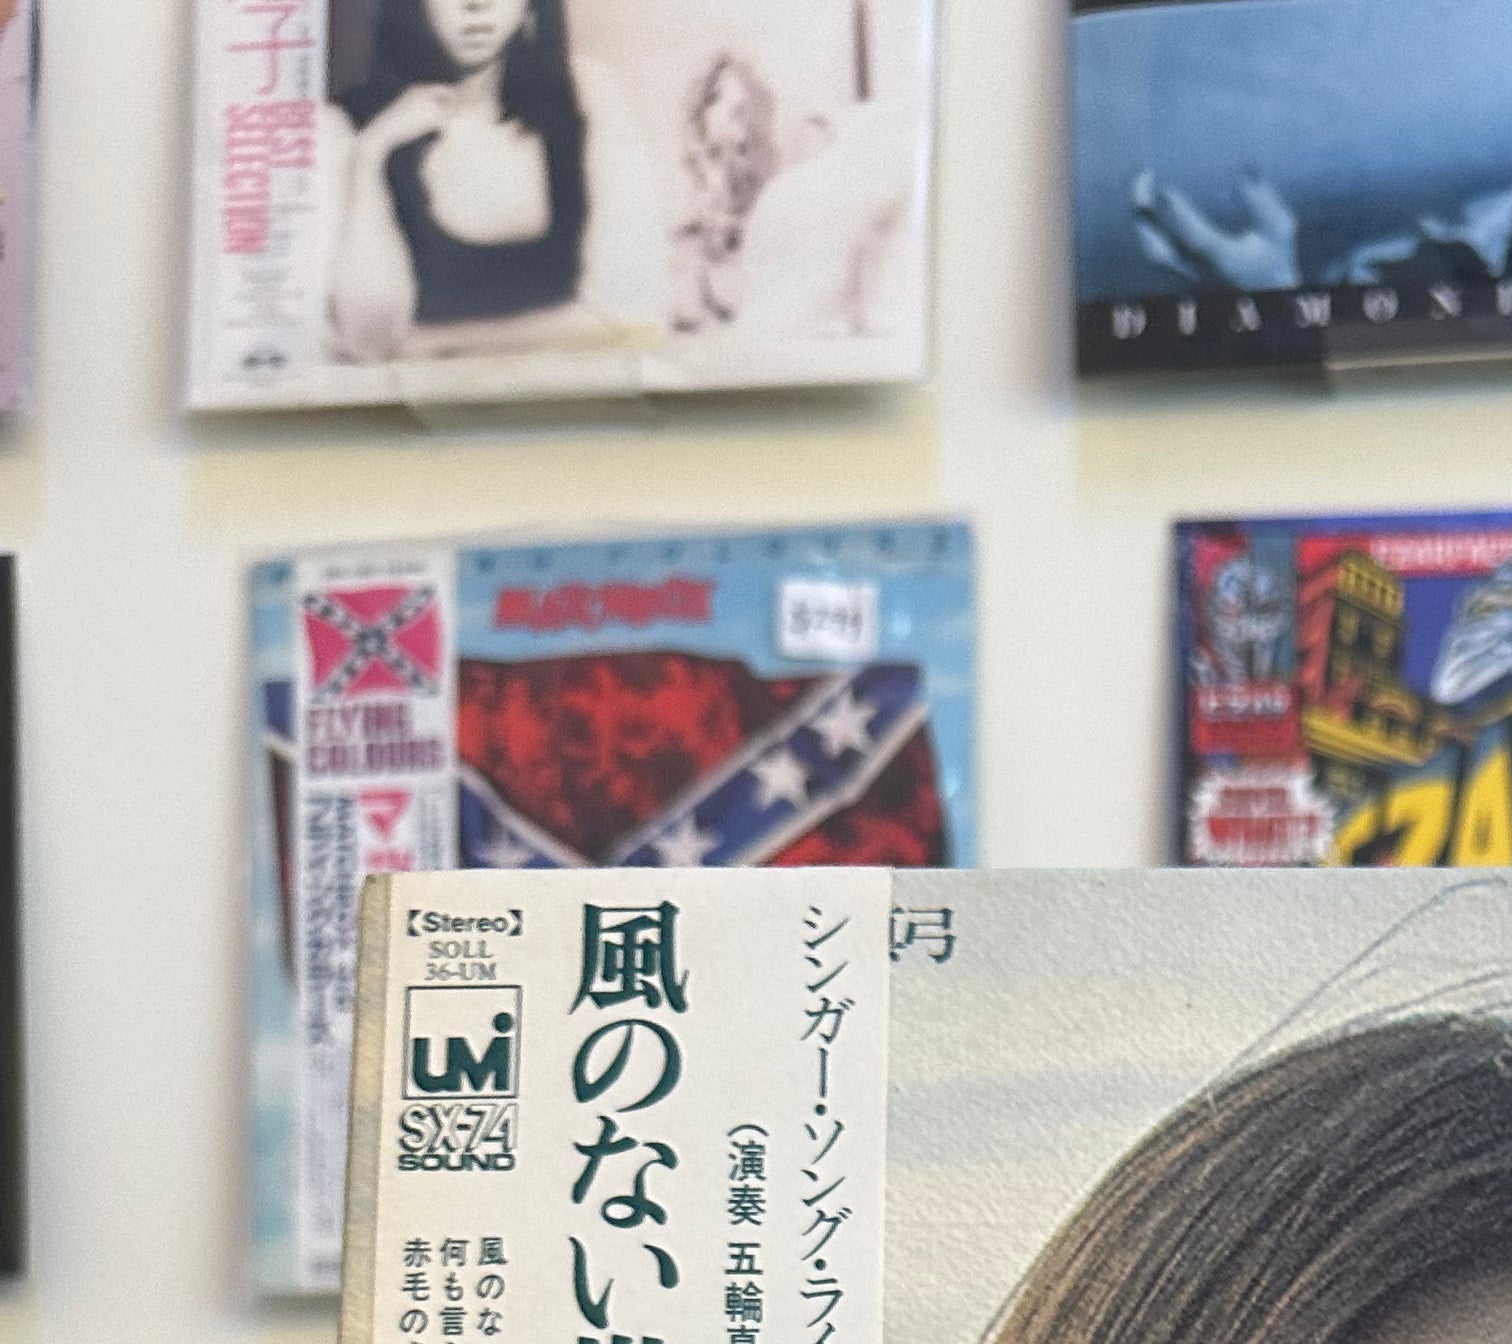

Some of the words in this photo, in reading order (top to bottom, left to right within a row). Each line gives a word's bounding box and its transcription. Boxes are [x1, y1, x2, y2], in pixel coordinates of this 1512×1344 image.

[428, 939, 495, 960] SOLL
[399, 1102, 518, 1154] SX-74
[398, 1153, 516, 1172] SOUND
